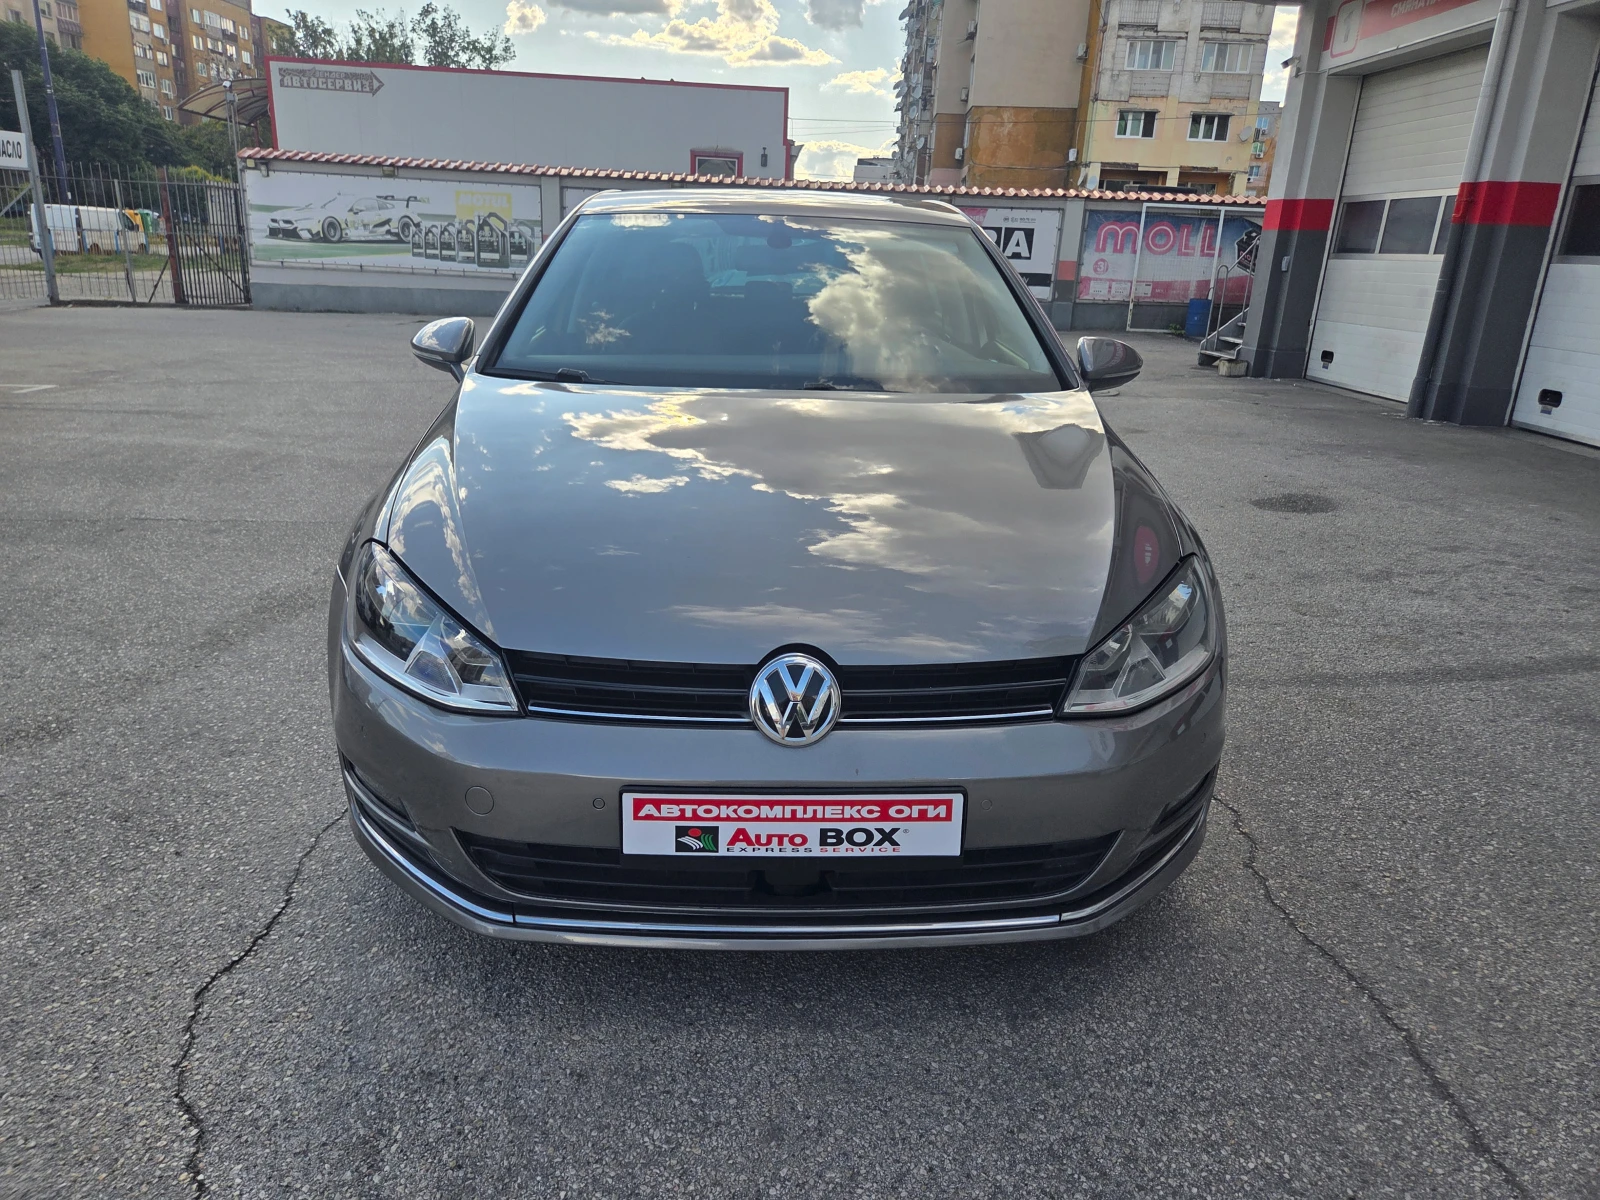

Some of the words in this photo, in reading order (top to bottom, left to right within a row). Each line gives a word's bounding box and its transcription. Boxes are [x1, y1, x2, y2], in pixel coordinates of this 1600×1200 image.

[283, 75, 371, 92] АВТОСЕРВИЗ
[0, 139, 22, 159] АСЛО
[458, 193, 510, 208] MOTUL
[1095, 220, 1223, 258] MOLL
[637, 804, 881, 819] АВТОКОМПЛЕКС
[888, 804, 947, 819] ОГИ
[819, 827, 901, 847] BOX
